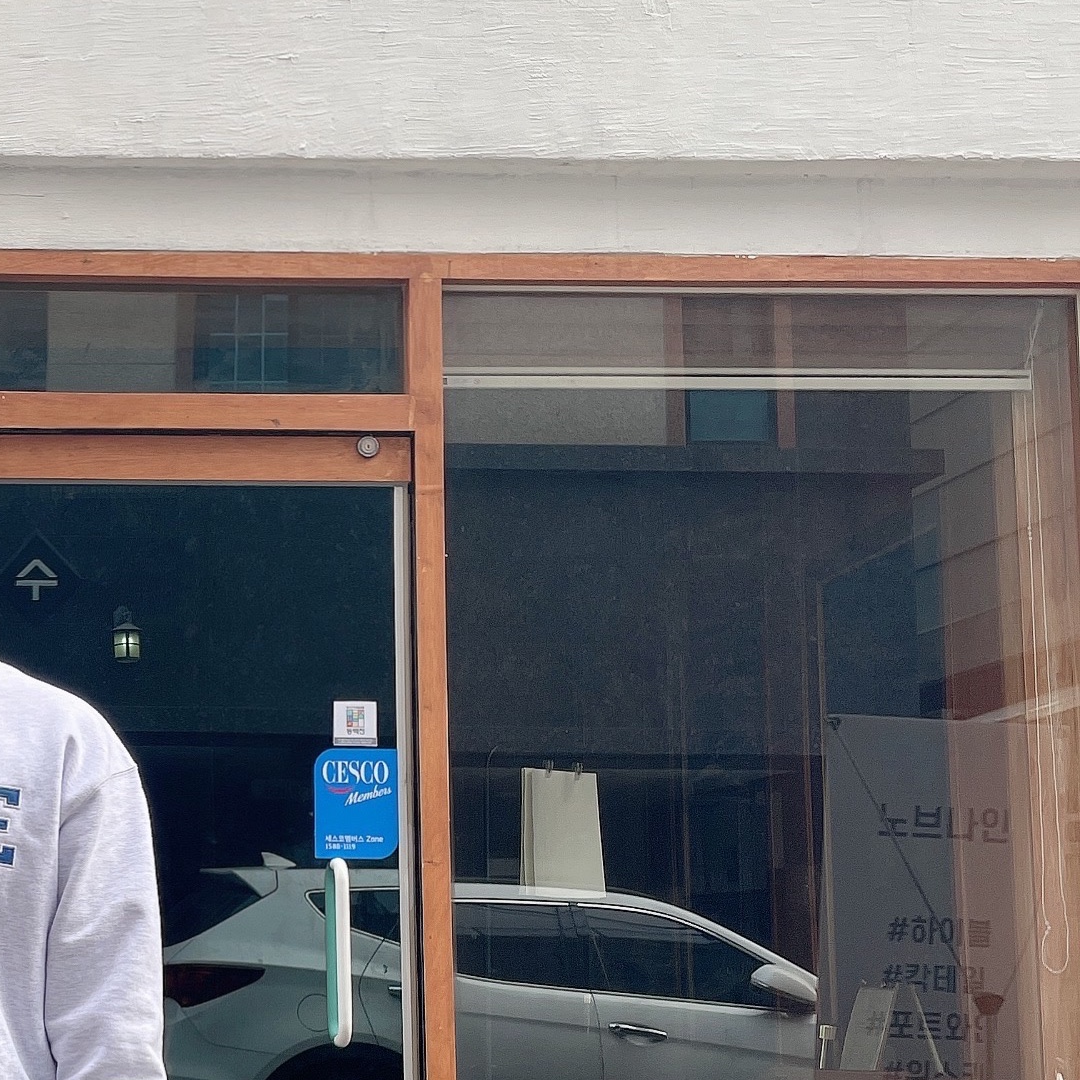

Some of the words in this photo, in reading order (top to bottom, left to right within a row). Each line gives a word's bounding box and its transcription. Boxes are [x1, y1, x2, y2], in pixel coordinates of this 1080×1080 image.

[322, 759, 389, 784] CESCO
[344, 784, 392, 807] Members
[877, 803, 1009, 843] 노브나인
[366, 835, 384, 843] Zone
